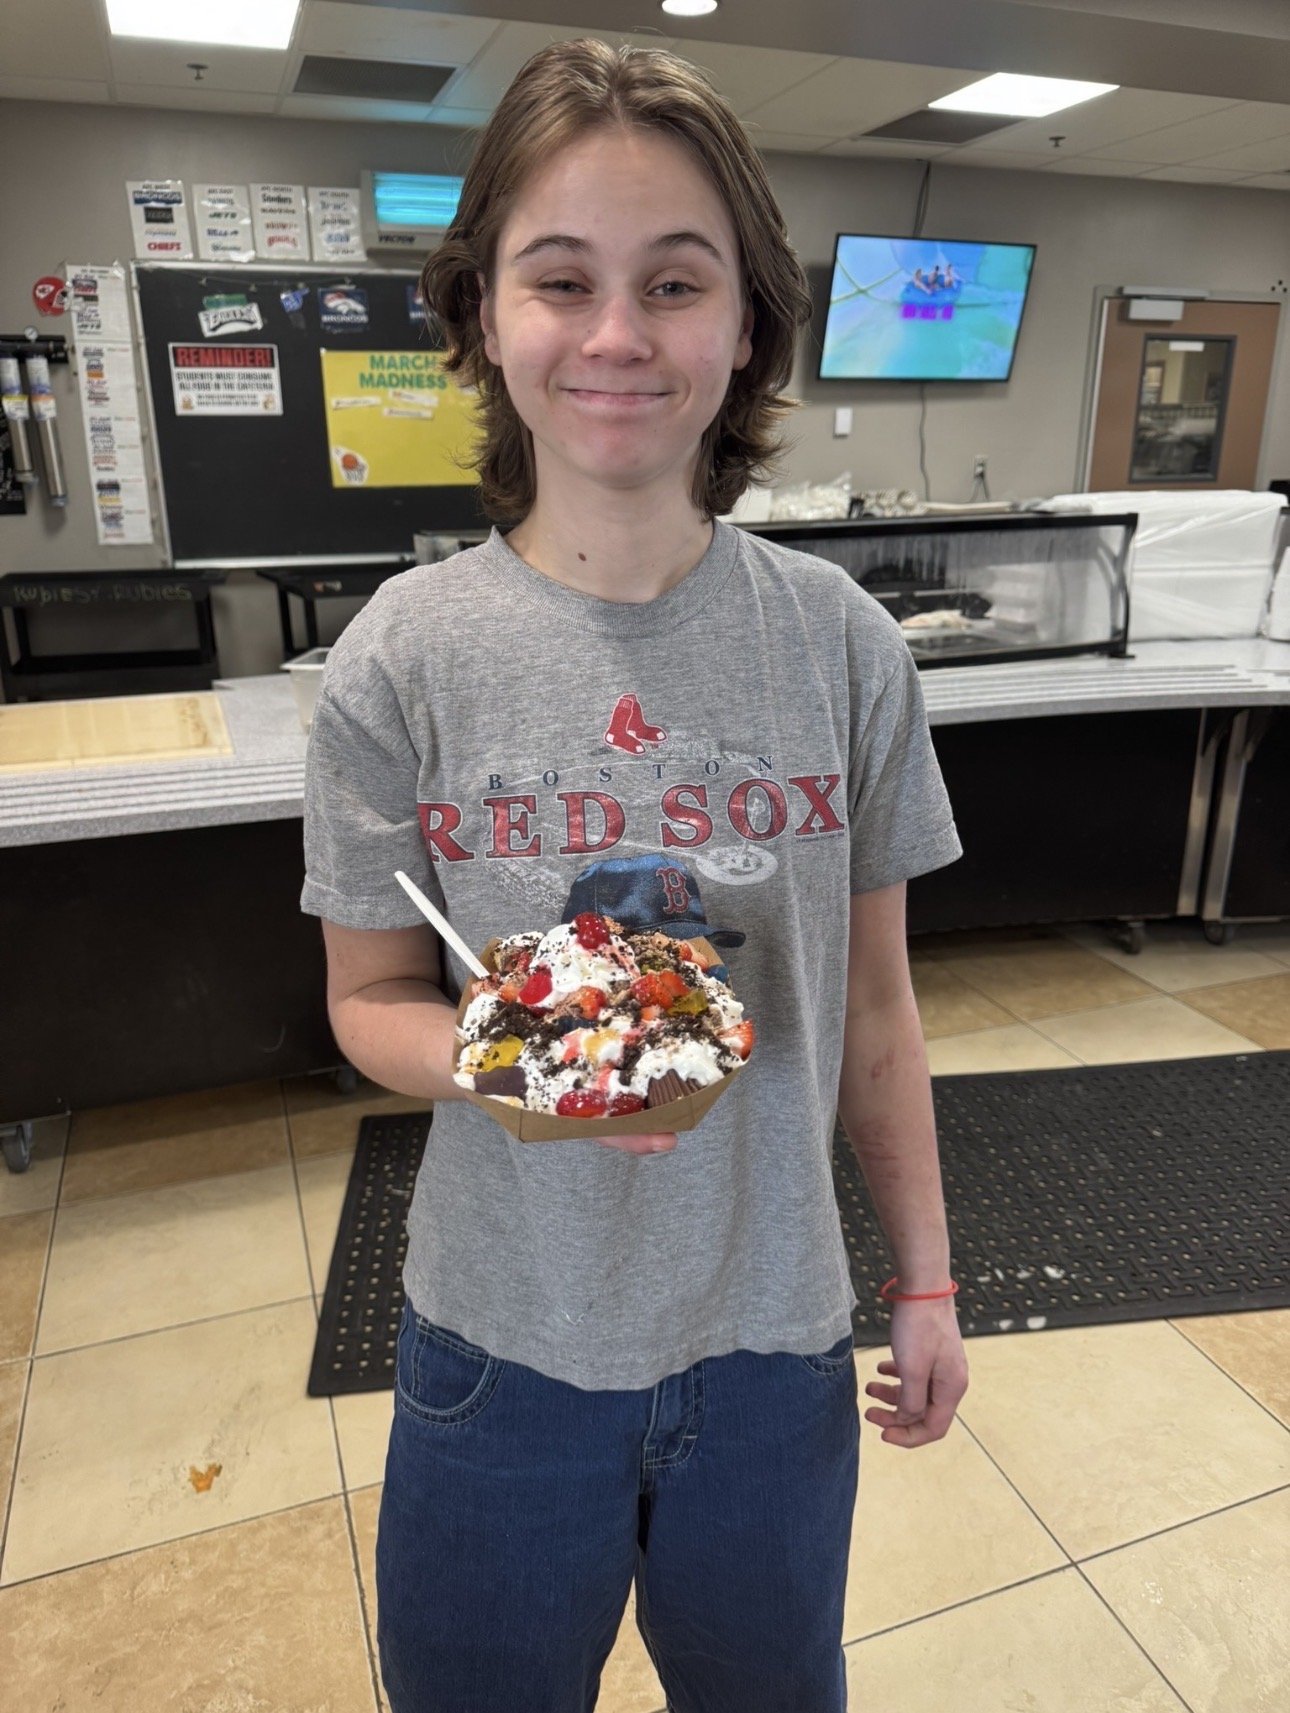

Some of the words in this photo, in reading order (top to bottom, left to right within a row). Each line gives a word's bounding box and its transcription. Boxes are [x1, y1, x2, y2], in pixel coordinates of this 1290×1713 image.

[147, 242, 181, 251] CHIEFS
[176, 347, 272, 368] REMINDER!
[369, 355, 438, 371] MARCH
[359, 373, 448, 389] MADNESS
[488, 755, 774, 791] BOSTON
[417, 790, 626, 863] RED
[660, 773, 846, 849] SOX
[656, 867, 692, 915] B
